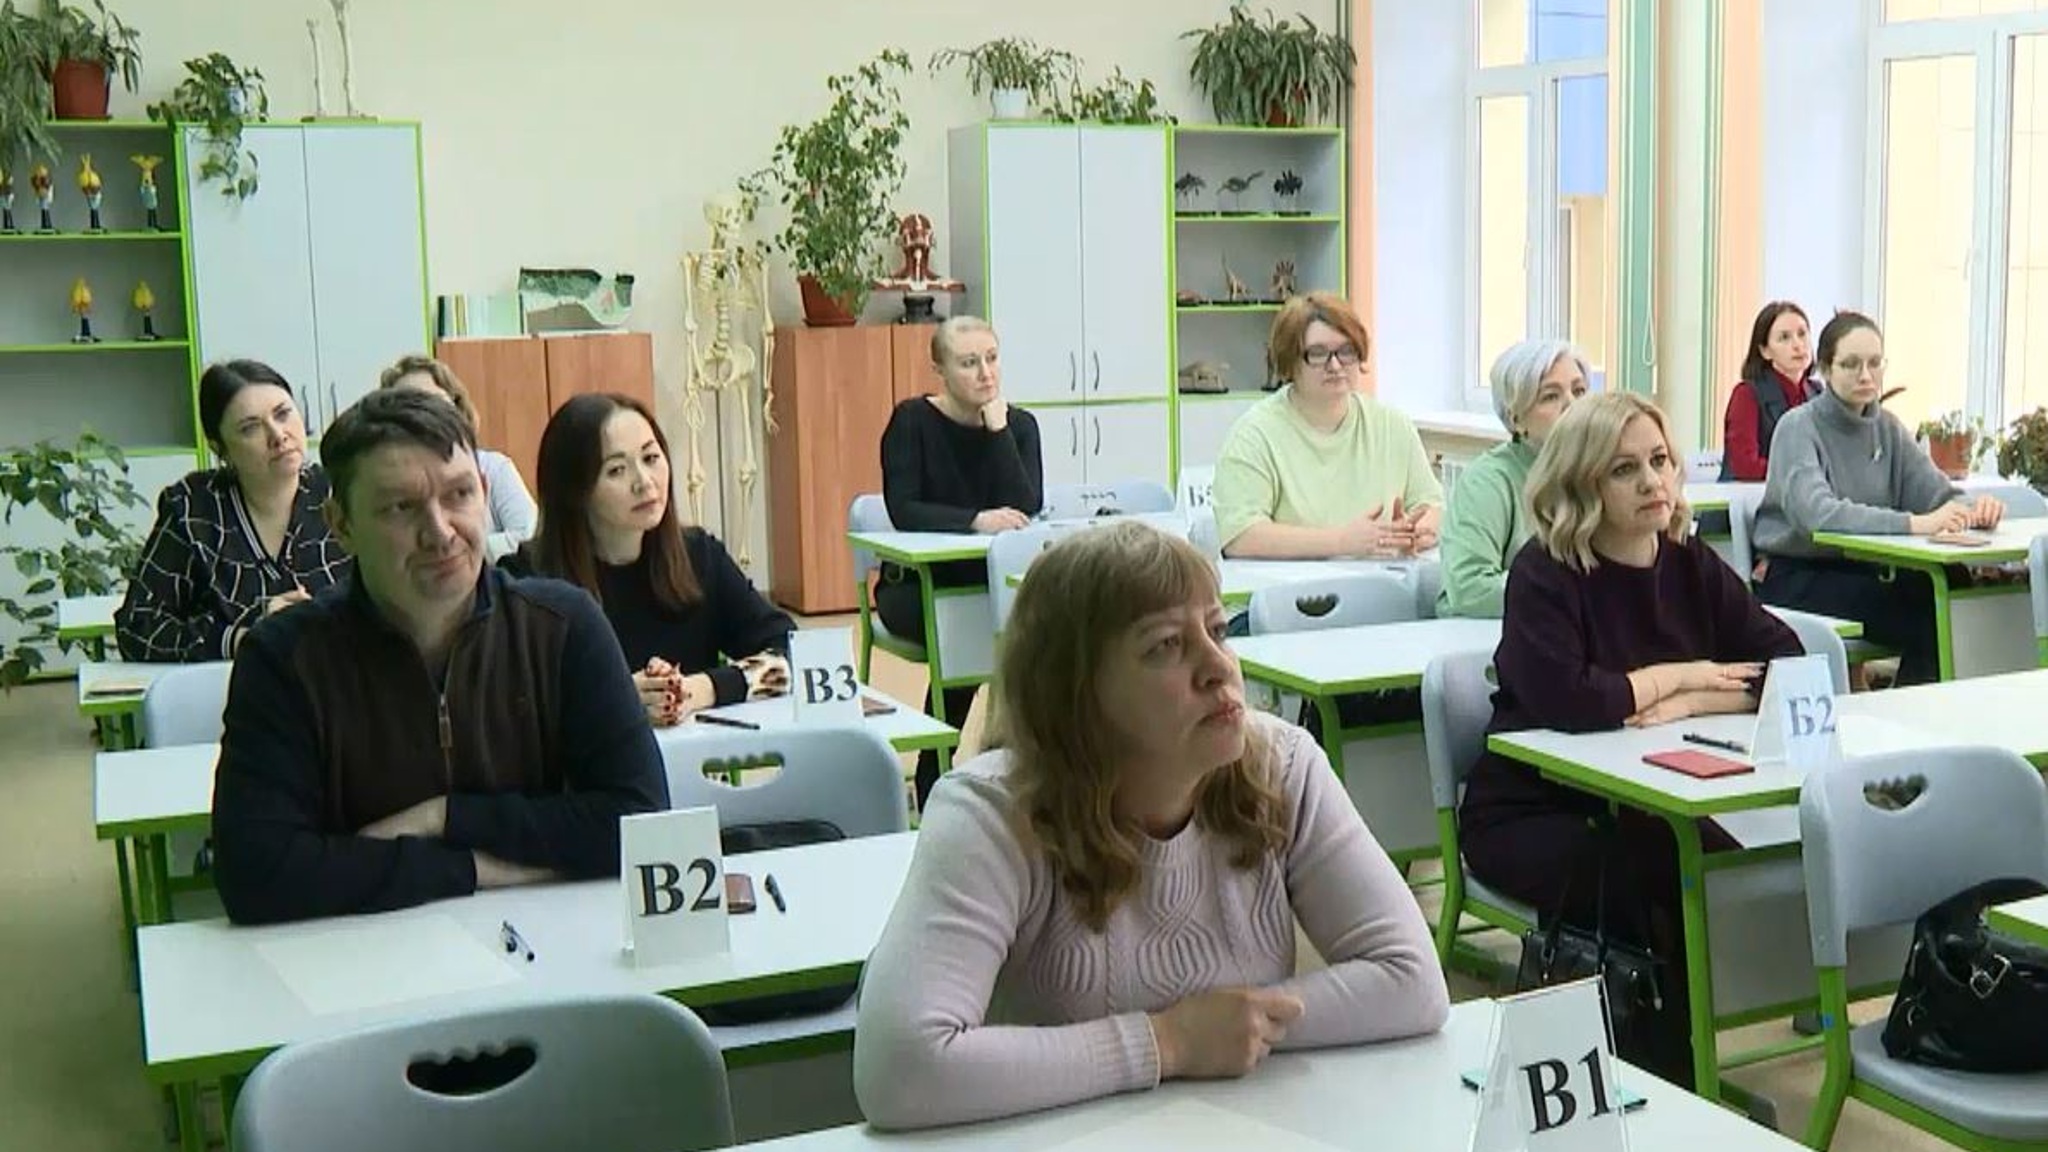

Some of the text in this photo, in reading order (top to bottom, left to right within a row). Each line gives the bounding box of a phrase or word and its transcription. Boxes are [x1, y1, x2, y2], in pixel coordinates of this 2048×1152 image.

[802, 664, 858, 705] В3
[1787, 696, 1836, 736] Б2
[634, 858, 721, 917] В2
[1518, 1046, 1611, 1134] В1
